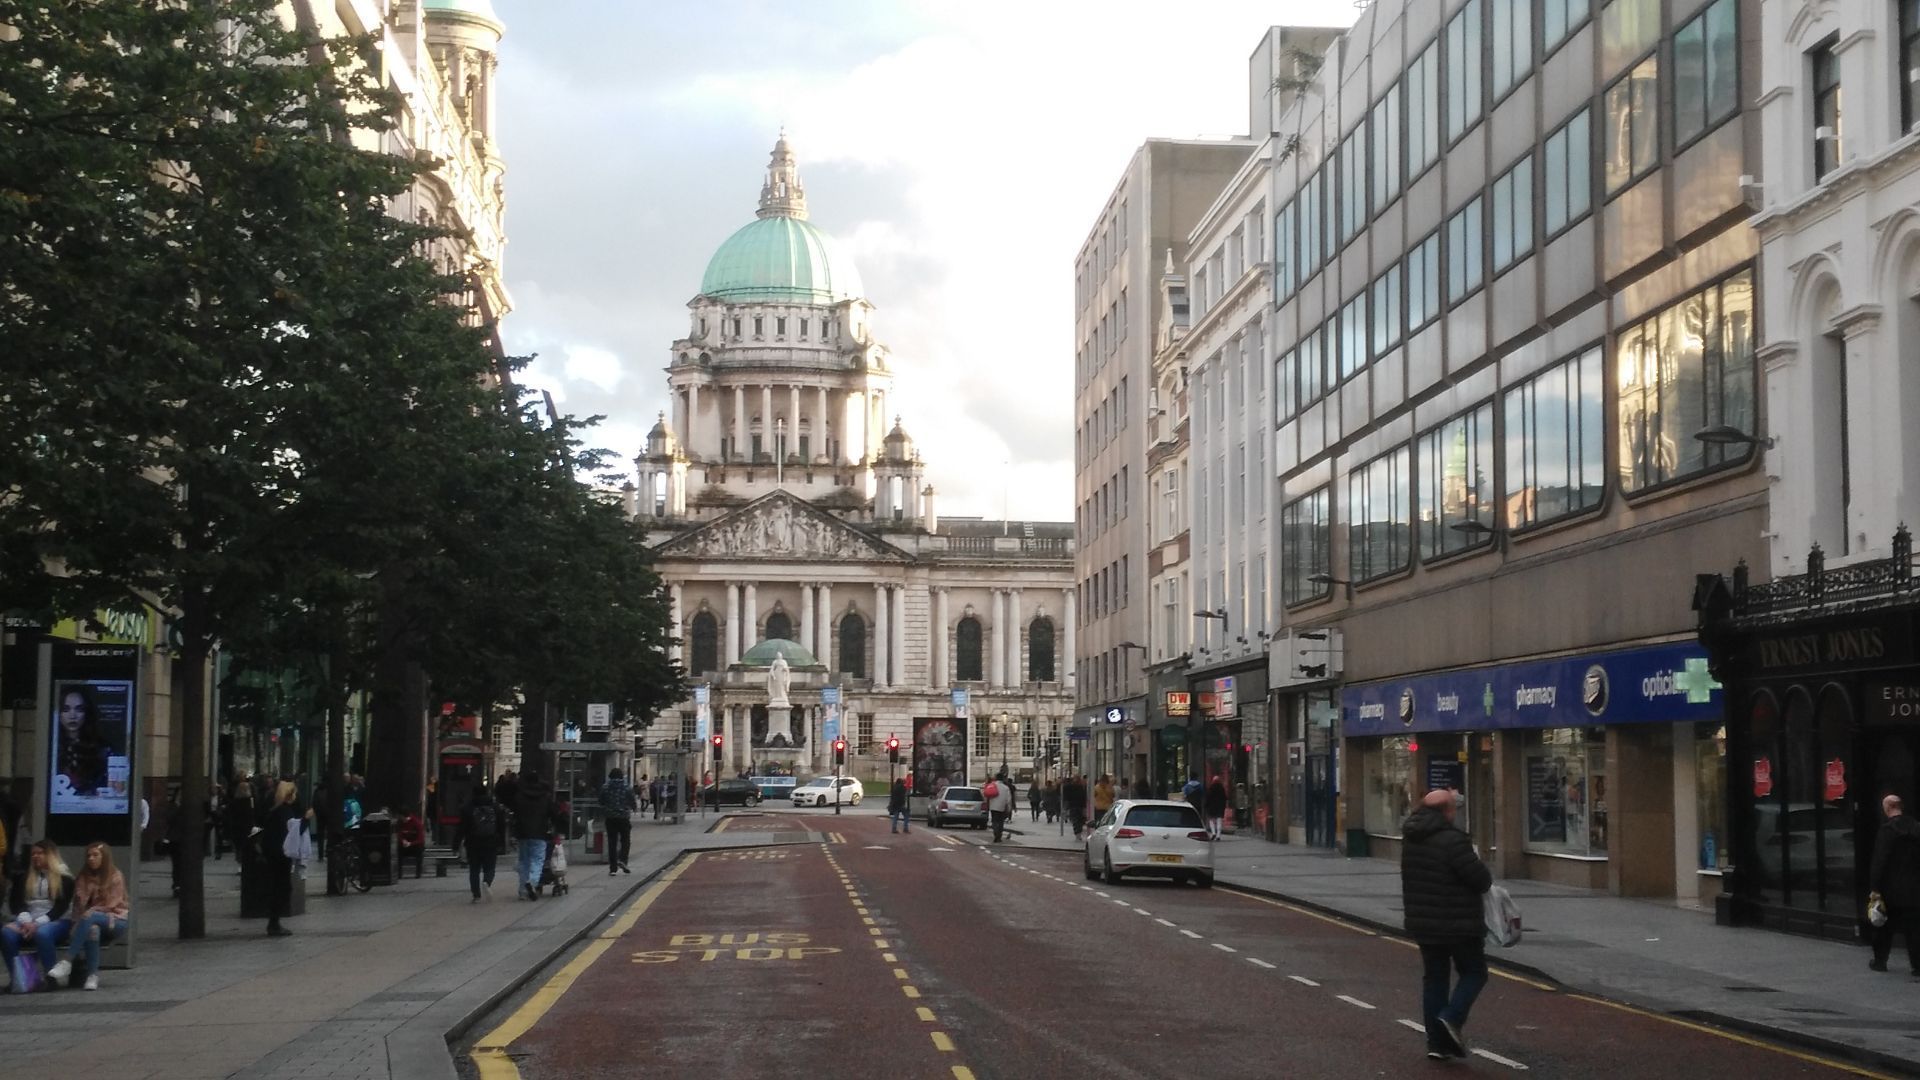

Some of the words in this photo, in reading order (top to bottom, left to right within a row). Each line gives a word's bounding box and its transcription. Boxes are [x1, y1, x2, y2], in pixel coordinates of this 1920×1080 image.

[1760, 635, 1819, 667] ERNEST
[1827, 628, 1884, 661] JONES
[1437, 692, 1459, 715] beauty
[1516, 684, 1556, 710] pharmacy
[1359, 701, 1385, 721] pharmacy
[669, 933, 811, 946] BUS
[631, 947, 843, 964] STOP
